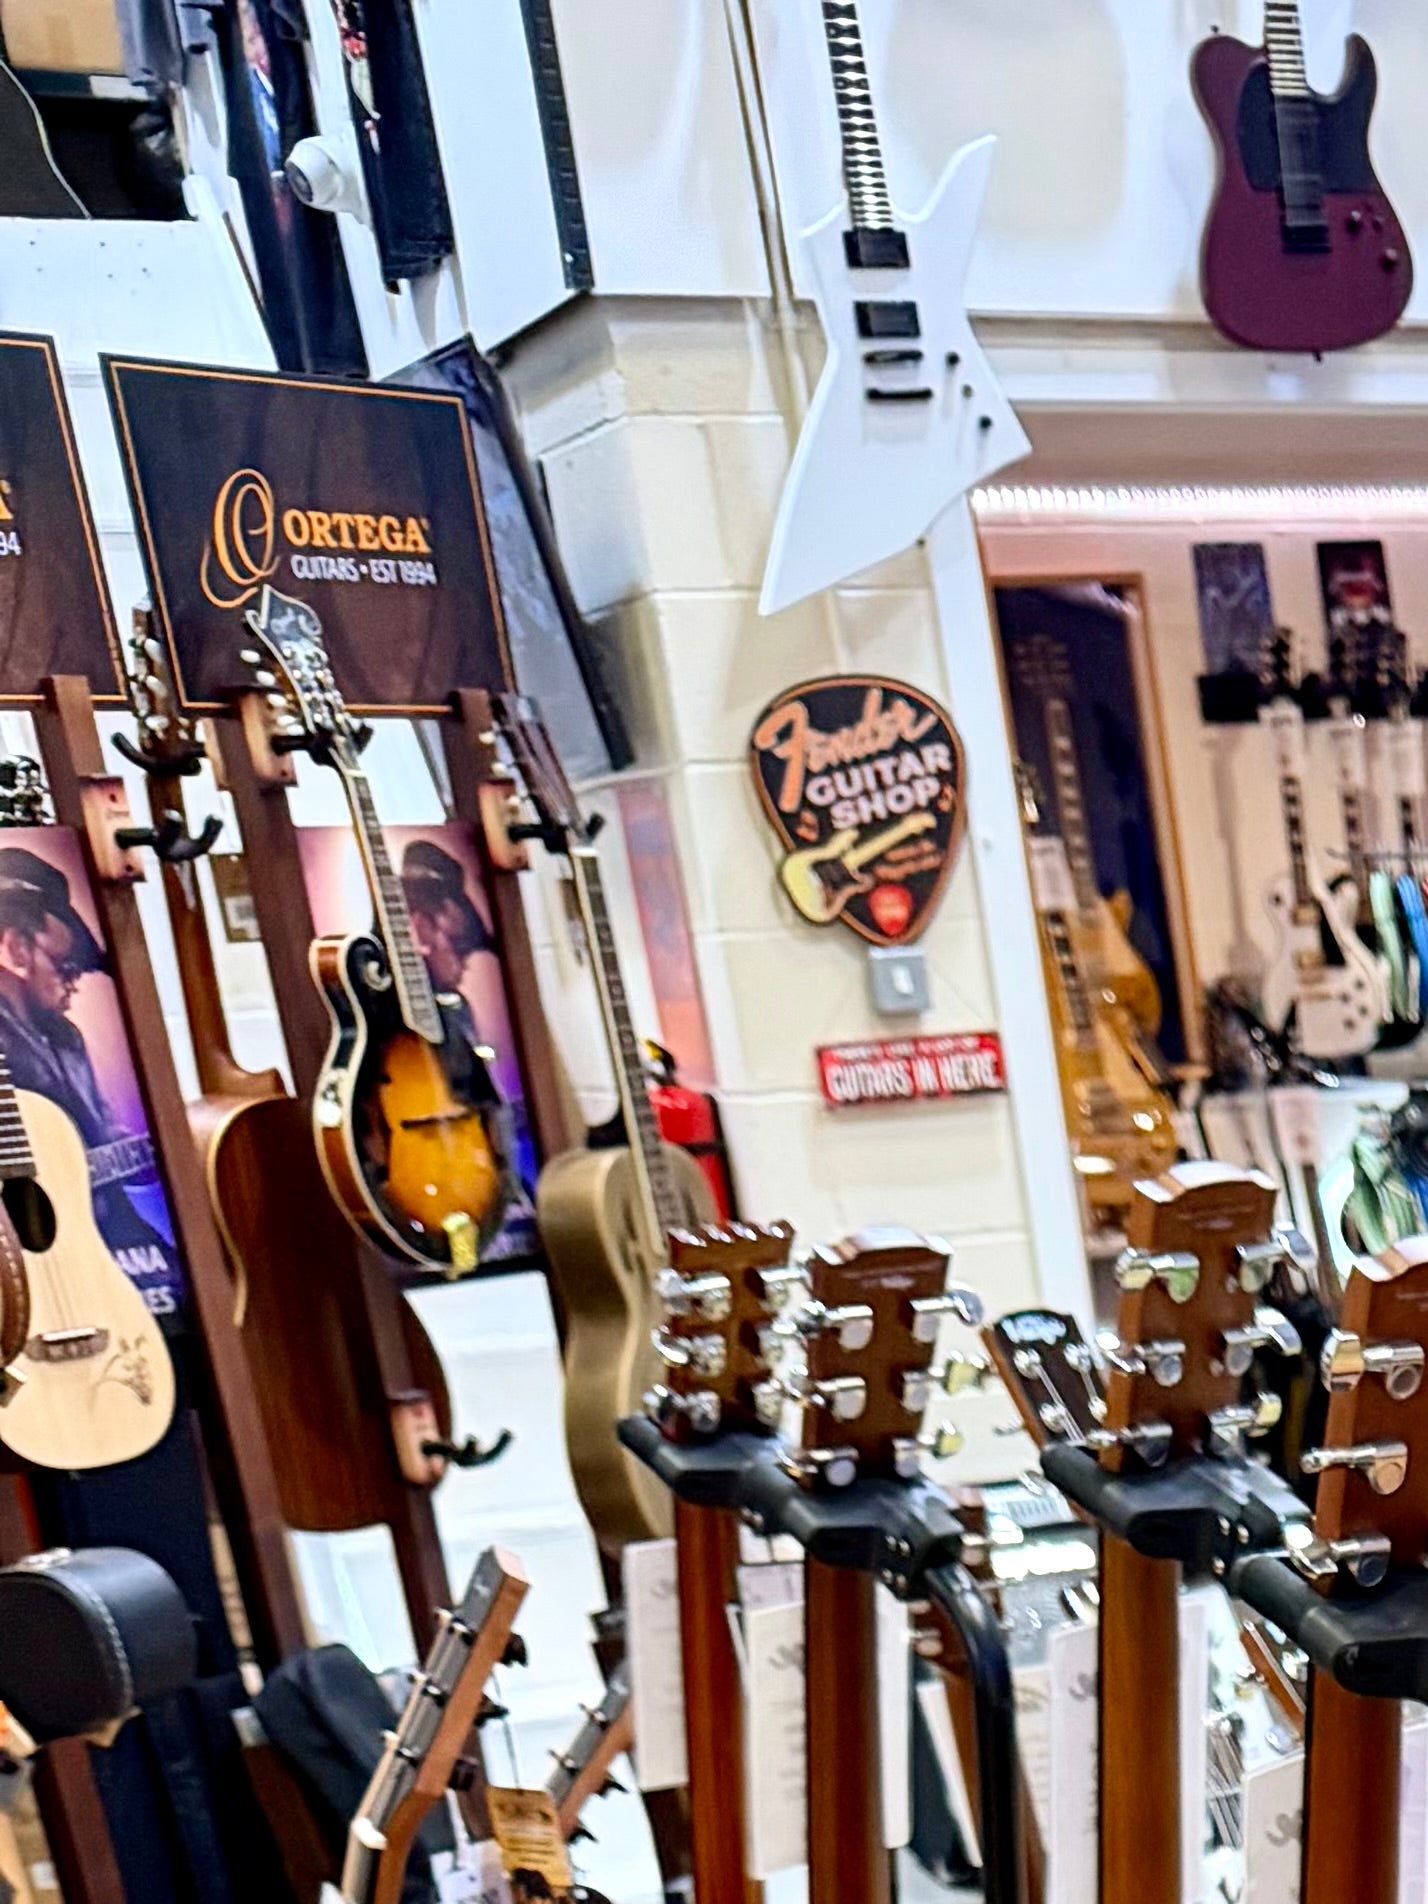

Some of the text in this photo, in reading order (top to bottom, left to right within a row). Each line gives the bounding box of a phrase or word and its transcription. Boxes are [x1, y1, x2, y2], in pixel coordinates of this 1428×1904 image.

[283, 509, 430, 553] ORTEGA
[290, 555, 357, 582] GUITARS
[369, 558, 399, 584] EST
[753, 688, 939, 813] Fender
[805, 742, 952, 807] GUITAR
[829, 777, 941, 830] SHOP
